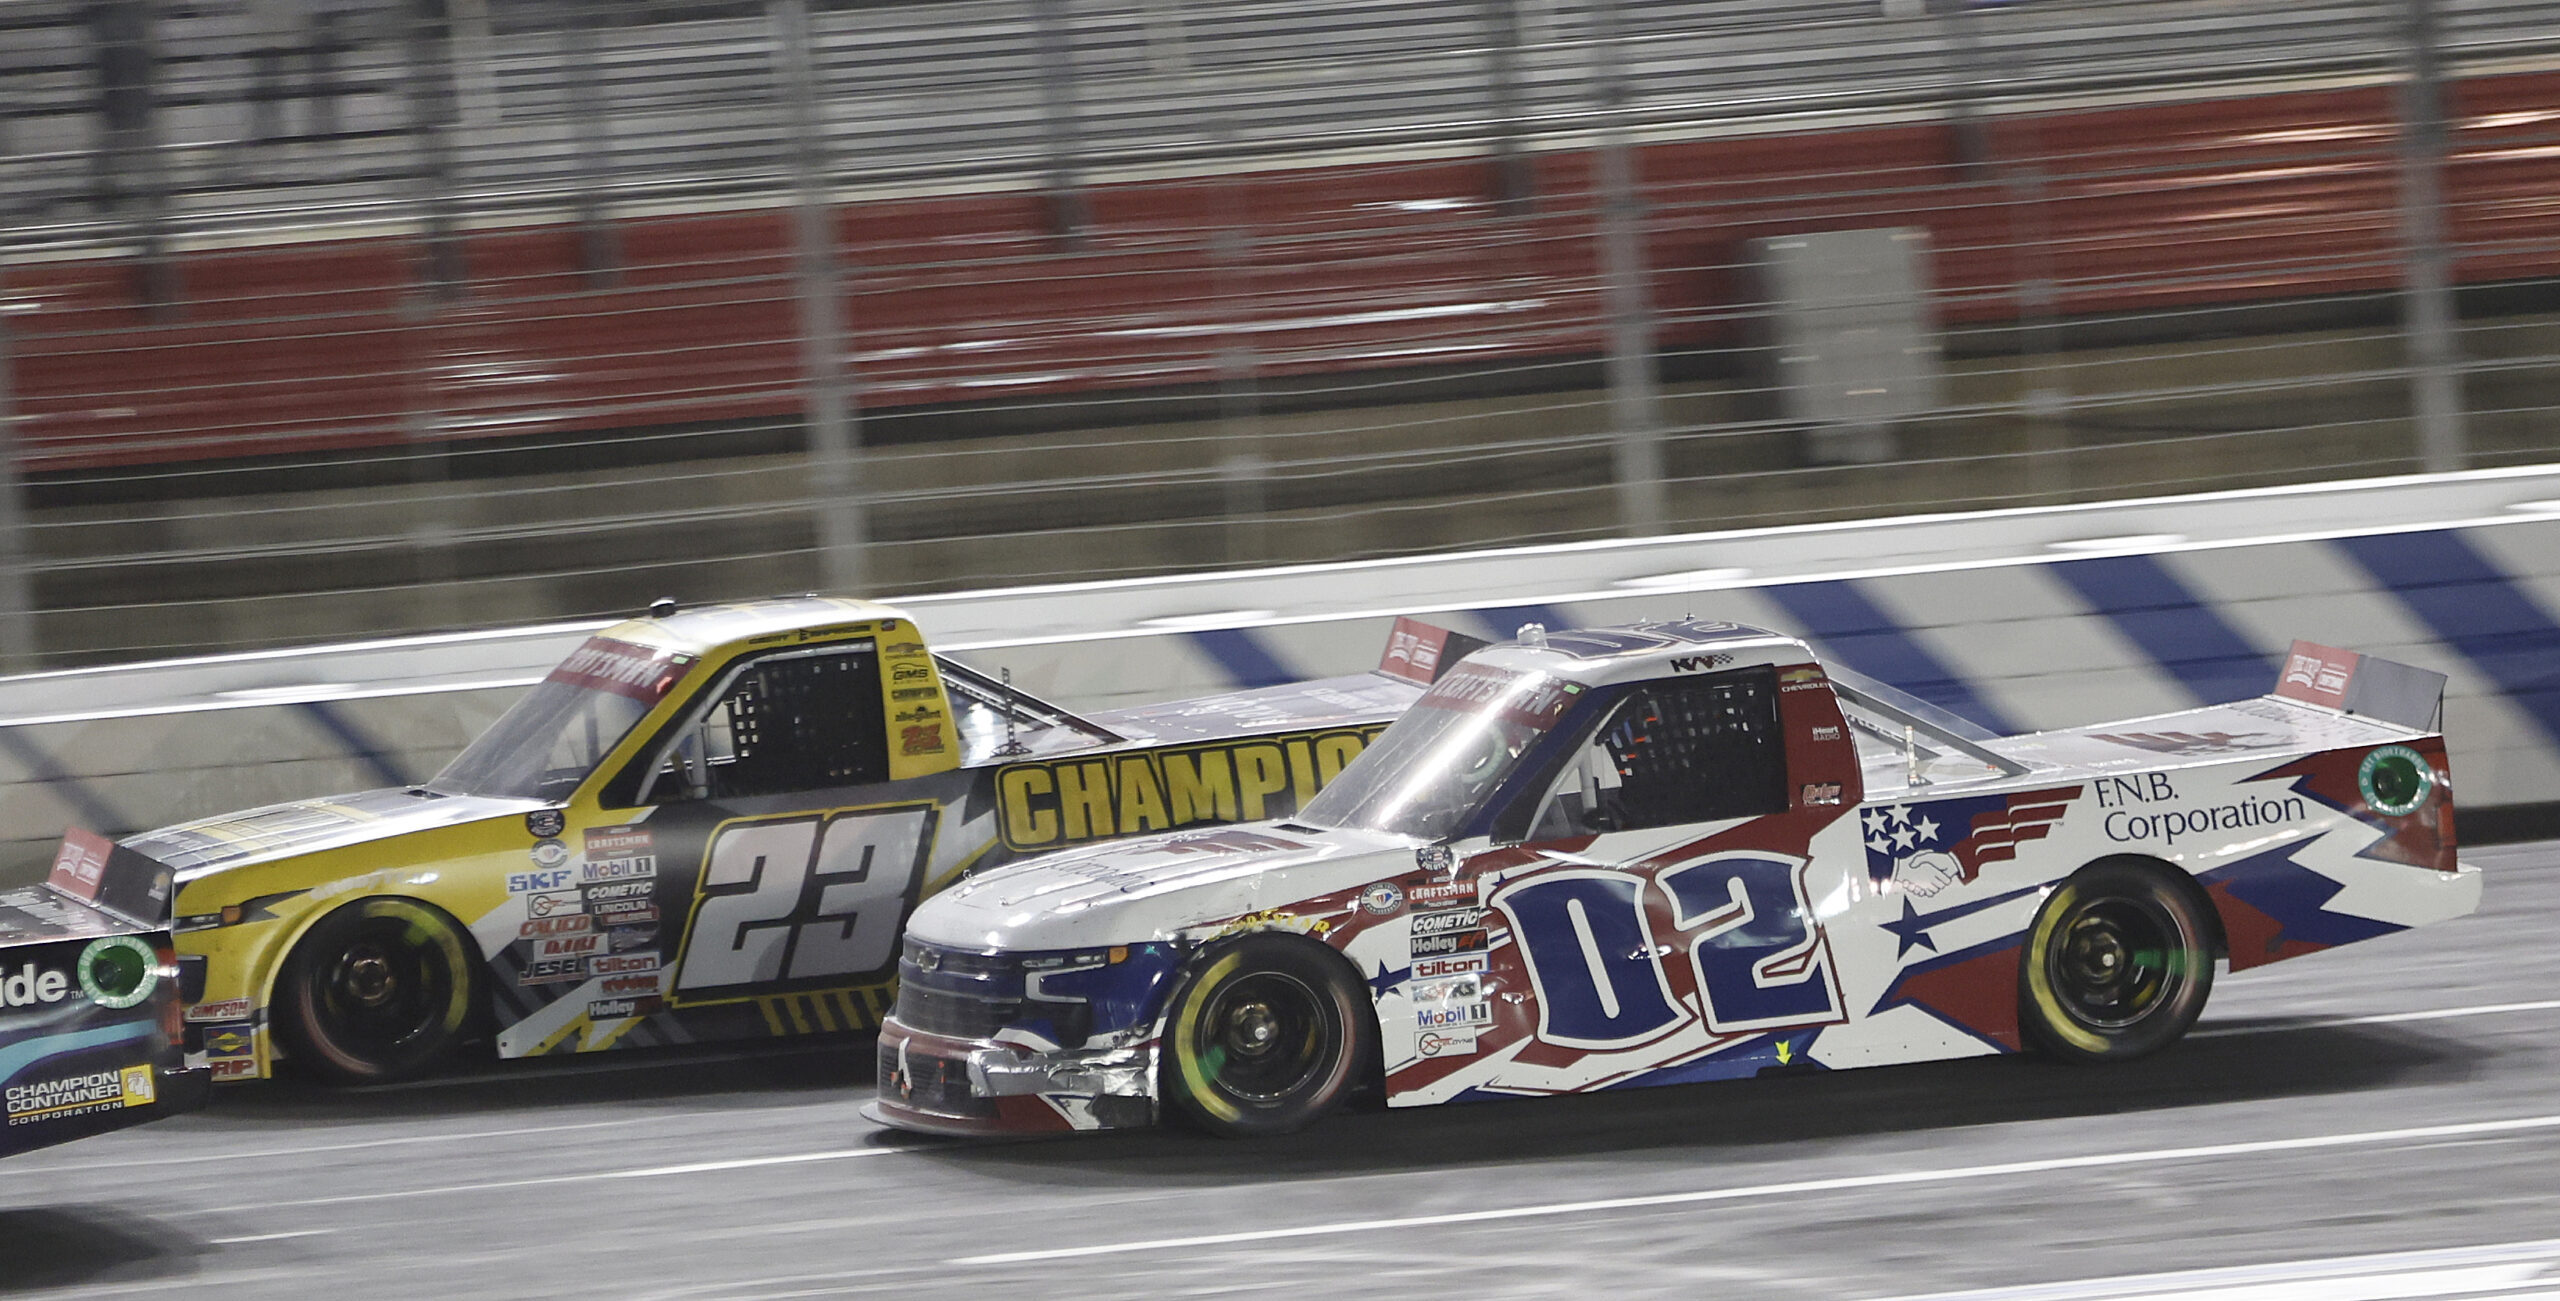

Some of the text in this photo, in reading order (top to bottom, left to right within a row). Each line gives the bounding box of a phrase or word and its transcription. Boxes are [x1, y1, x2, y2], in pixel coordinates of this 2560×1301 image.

[1781, 682, 1829, 693] CHEVROLET
[1812, 725, 1839, 735] iHeart
[1813, 733, 1841, 742] RADIO
[1000, 730, 1385, 846] CHAMPIO
[2094, 772, 2179, 808] F.N.B.
[2104, 796, 2306, 845] Corporation
[587, 834, 650, 850] CRAFTSMAN
[582, 859, 631, 879] Mobil
[509, 870, 572, 893] SKF
[587, 882, 653, 900] COMETIC
[676, 808, 932, 992] 23
[1410, 883, 1474, 901] CRAFTSMAN
[594, 900, 647, 915] LINCOLN
[1413, 908, 1479, 932] COMETIC
[1412, 936, 1457, 955] Holley
[1490, 850, 1845, 1050] 02
[519, 957, 585, 979] JESEL
[593, 956, 656, 973] tilton
[1416, 959, 1483, 977] tilton
[190, 1000, 249, 1018] SIMPSON
[589, 1000, 635, 1019] Holley
[1418, 1006, 1466, 1027] Mobil
[210, 1060, 255, 1076] RP
[4, 1069, 119, 1100] CHAMPION
[6, 1083, 121, 1114] CONTAINER
[8, 1100, 124, 1127] CORPORATION
